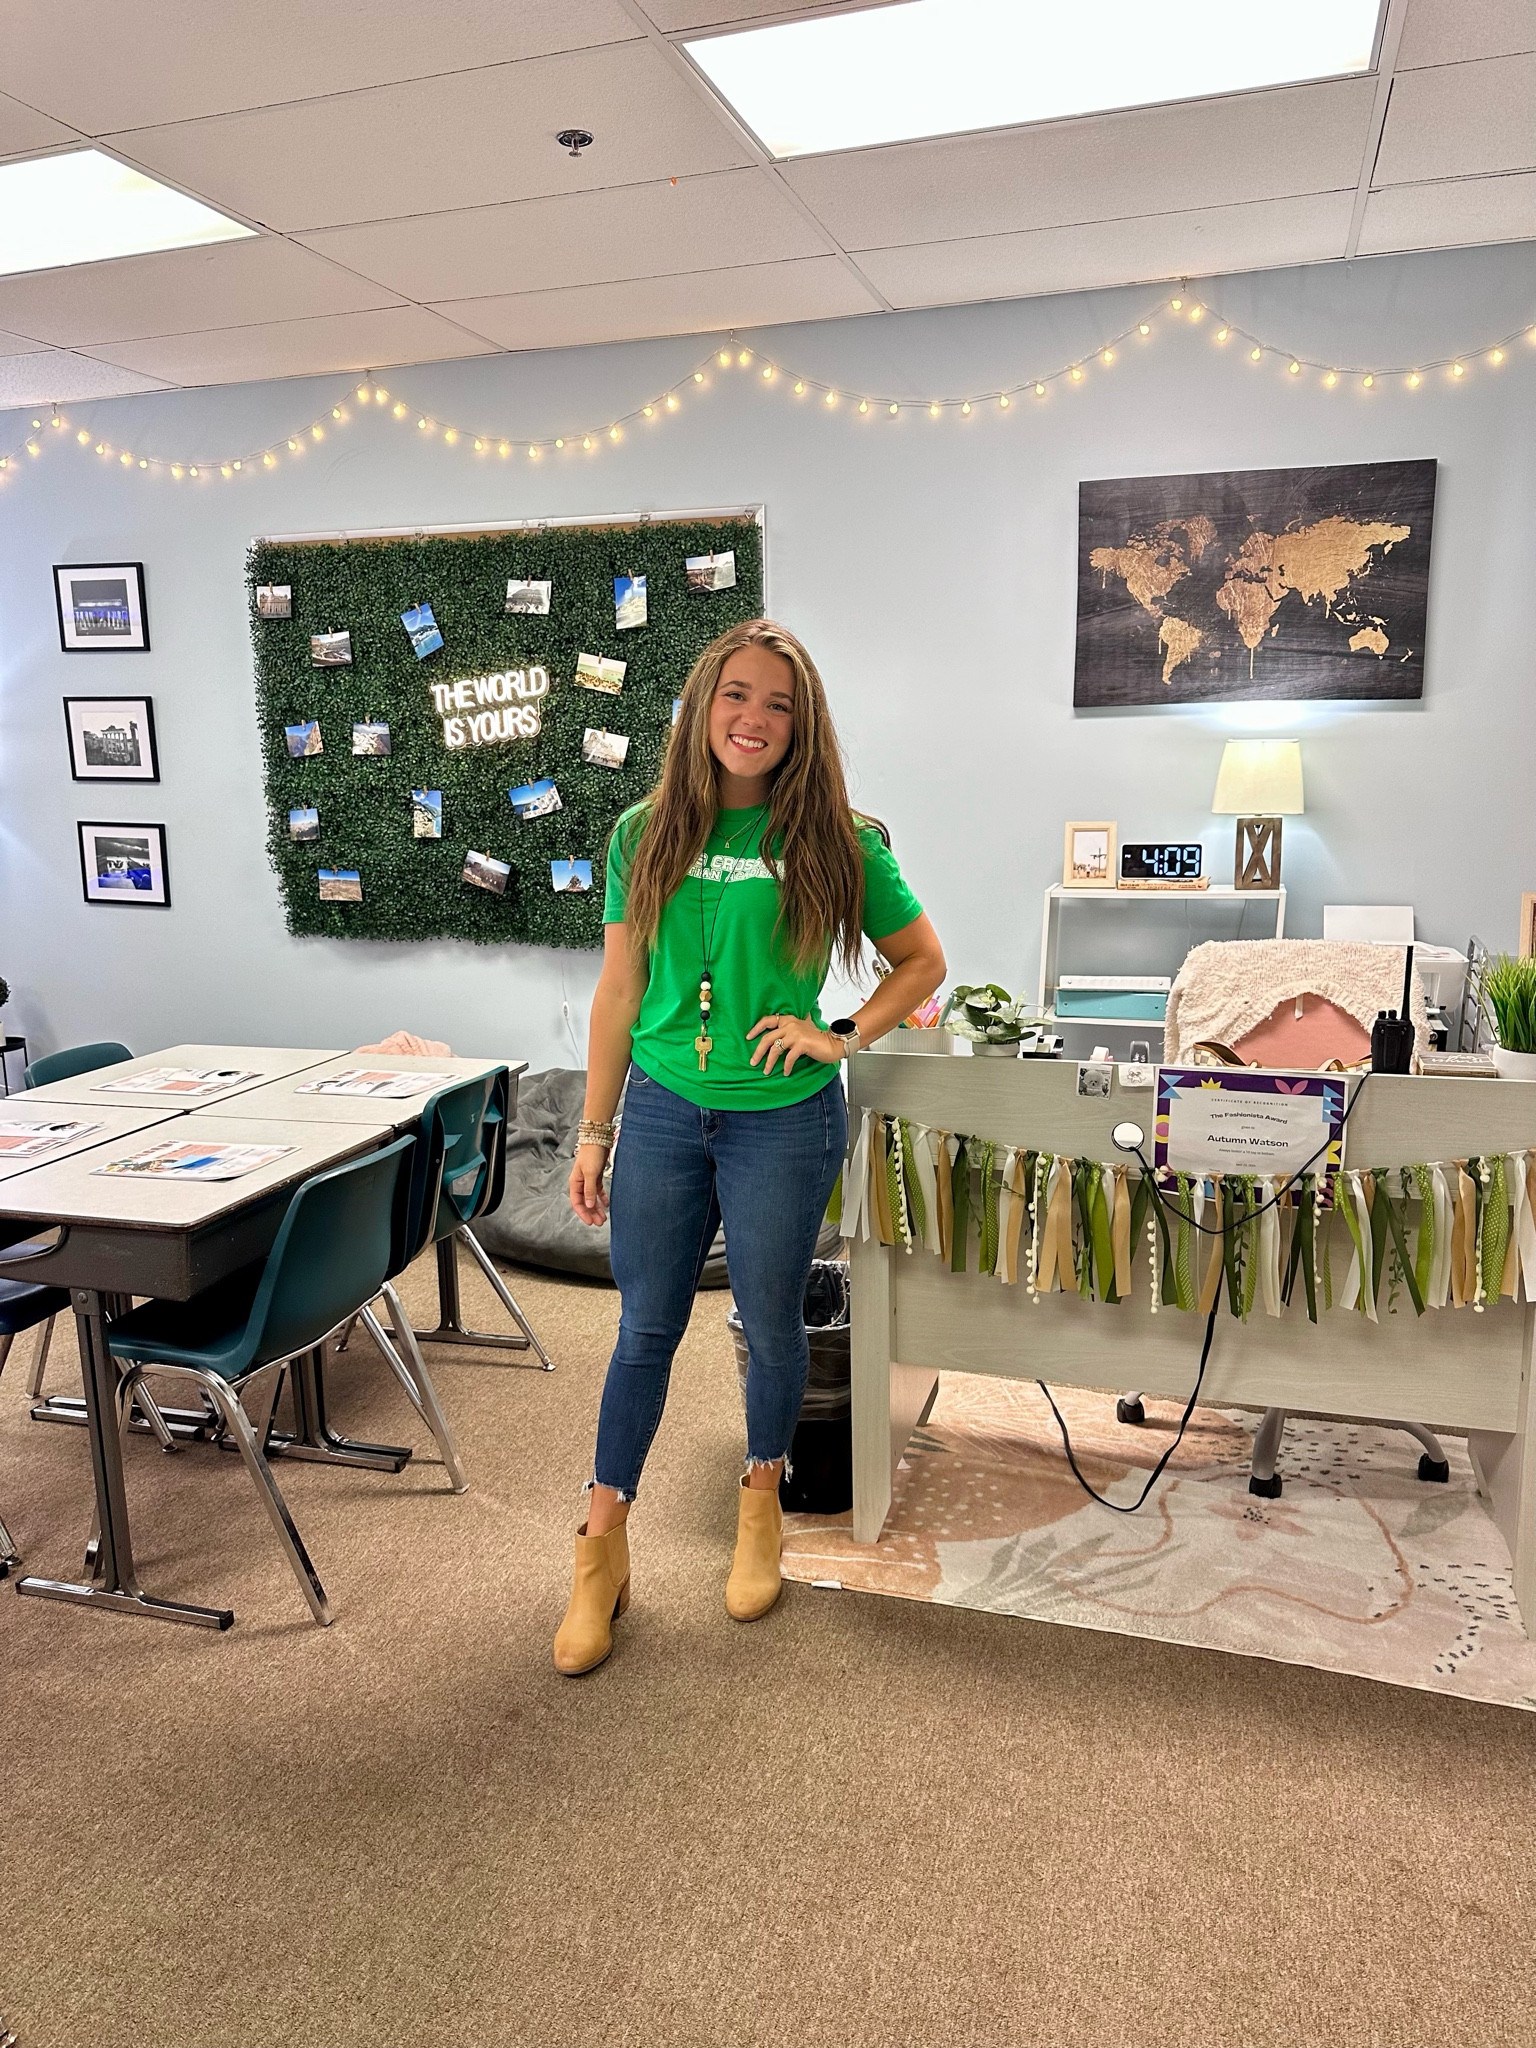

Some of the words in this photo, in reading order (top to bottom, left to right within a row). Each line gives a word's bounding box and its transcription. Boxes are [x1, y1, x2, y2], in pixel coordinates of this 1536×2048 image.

[431, 680, 476, 713] THE
[473, 667, 547, 705] WORLD
[444, 718, 466, 747] IS
[467, 705, 539, 743] YOURS
[1142, 847, 1201, 876] 4:09
[1265, 1115, 1288, 1125] Award
[1207, 1134, 1247, 1144] Autumn
[1249, 1137, 1289, 1147] Watson
